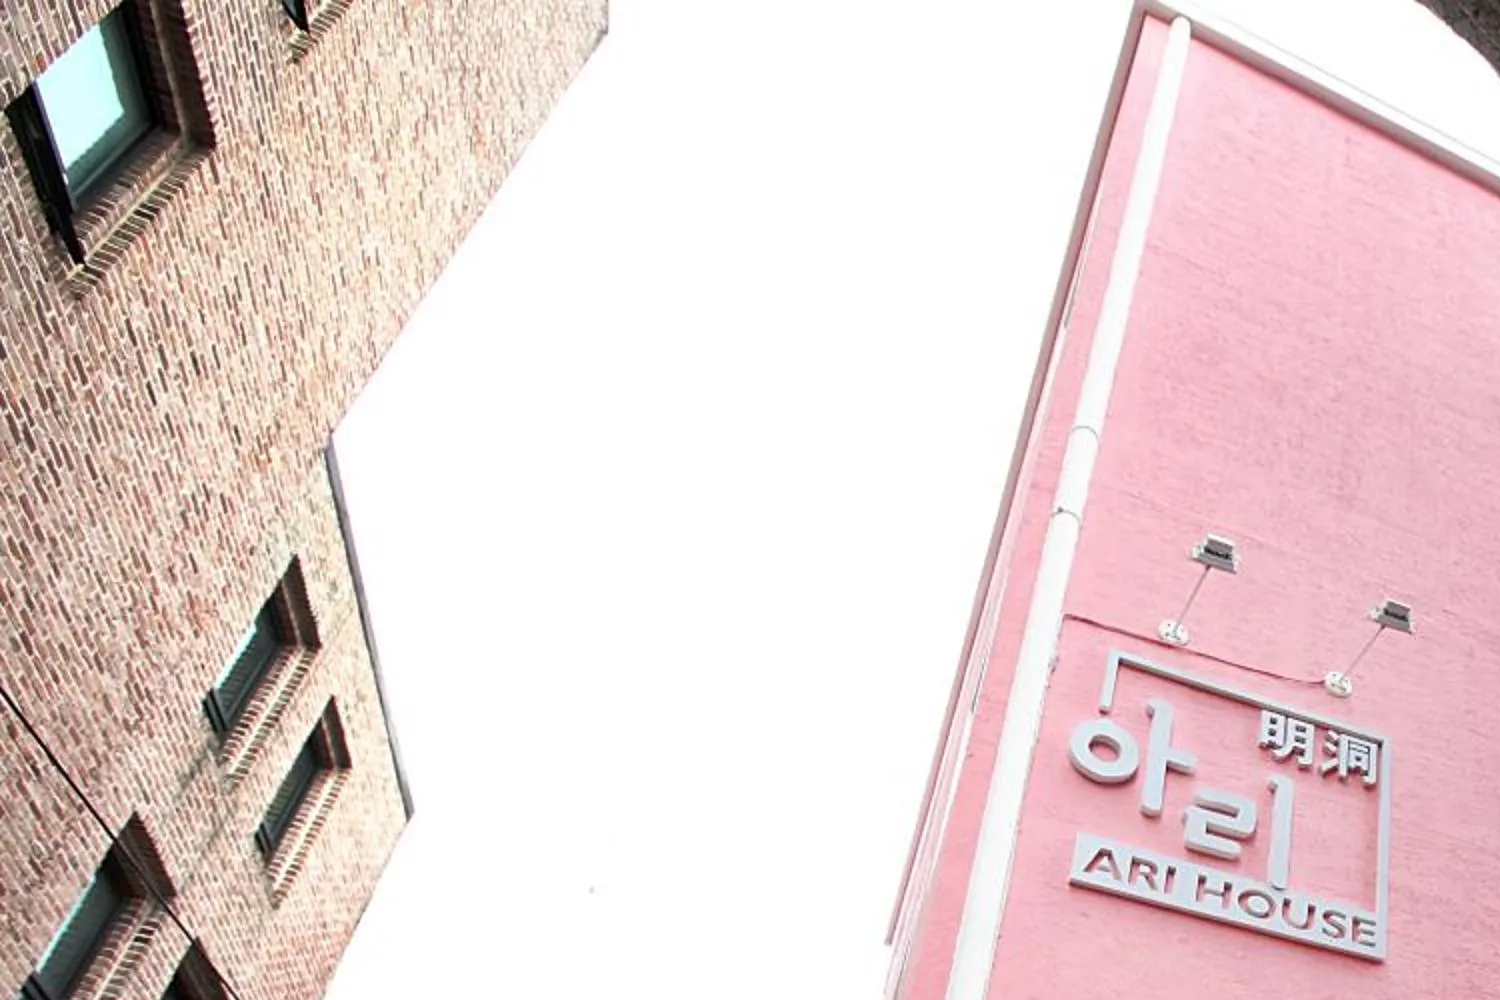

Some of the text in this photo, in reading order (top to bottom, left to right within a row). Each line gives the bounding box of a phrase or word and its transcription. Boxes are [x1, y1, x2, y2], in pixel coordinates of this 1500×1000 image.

[1068, 699, 1293, 889] 아리
[1258, 709, 1378, 788] 明洞
[1083, 847, 1378, 949] ARI HOUSE
